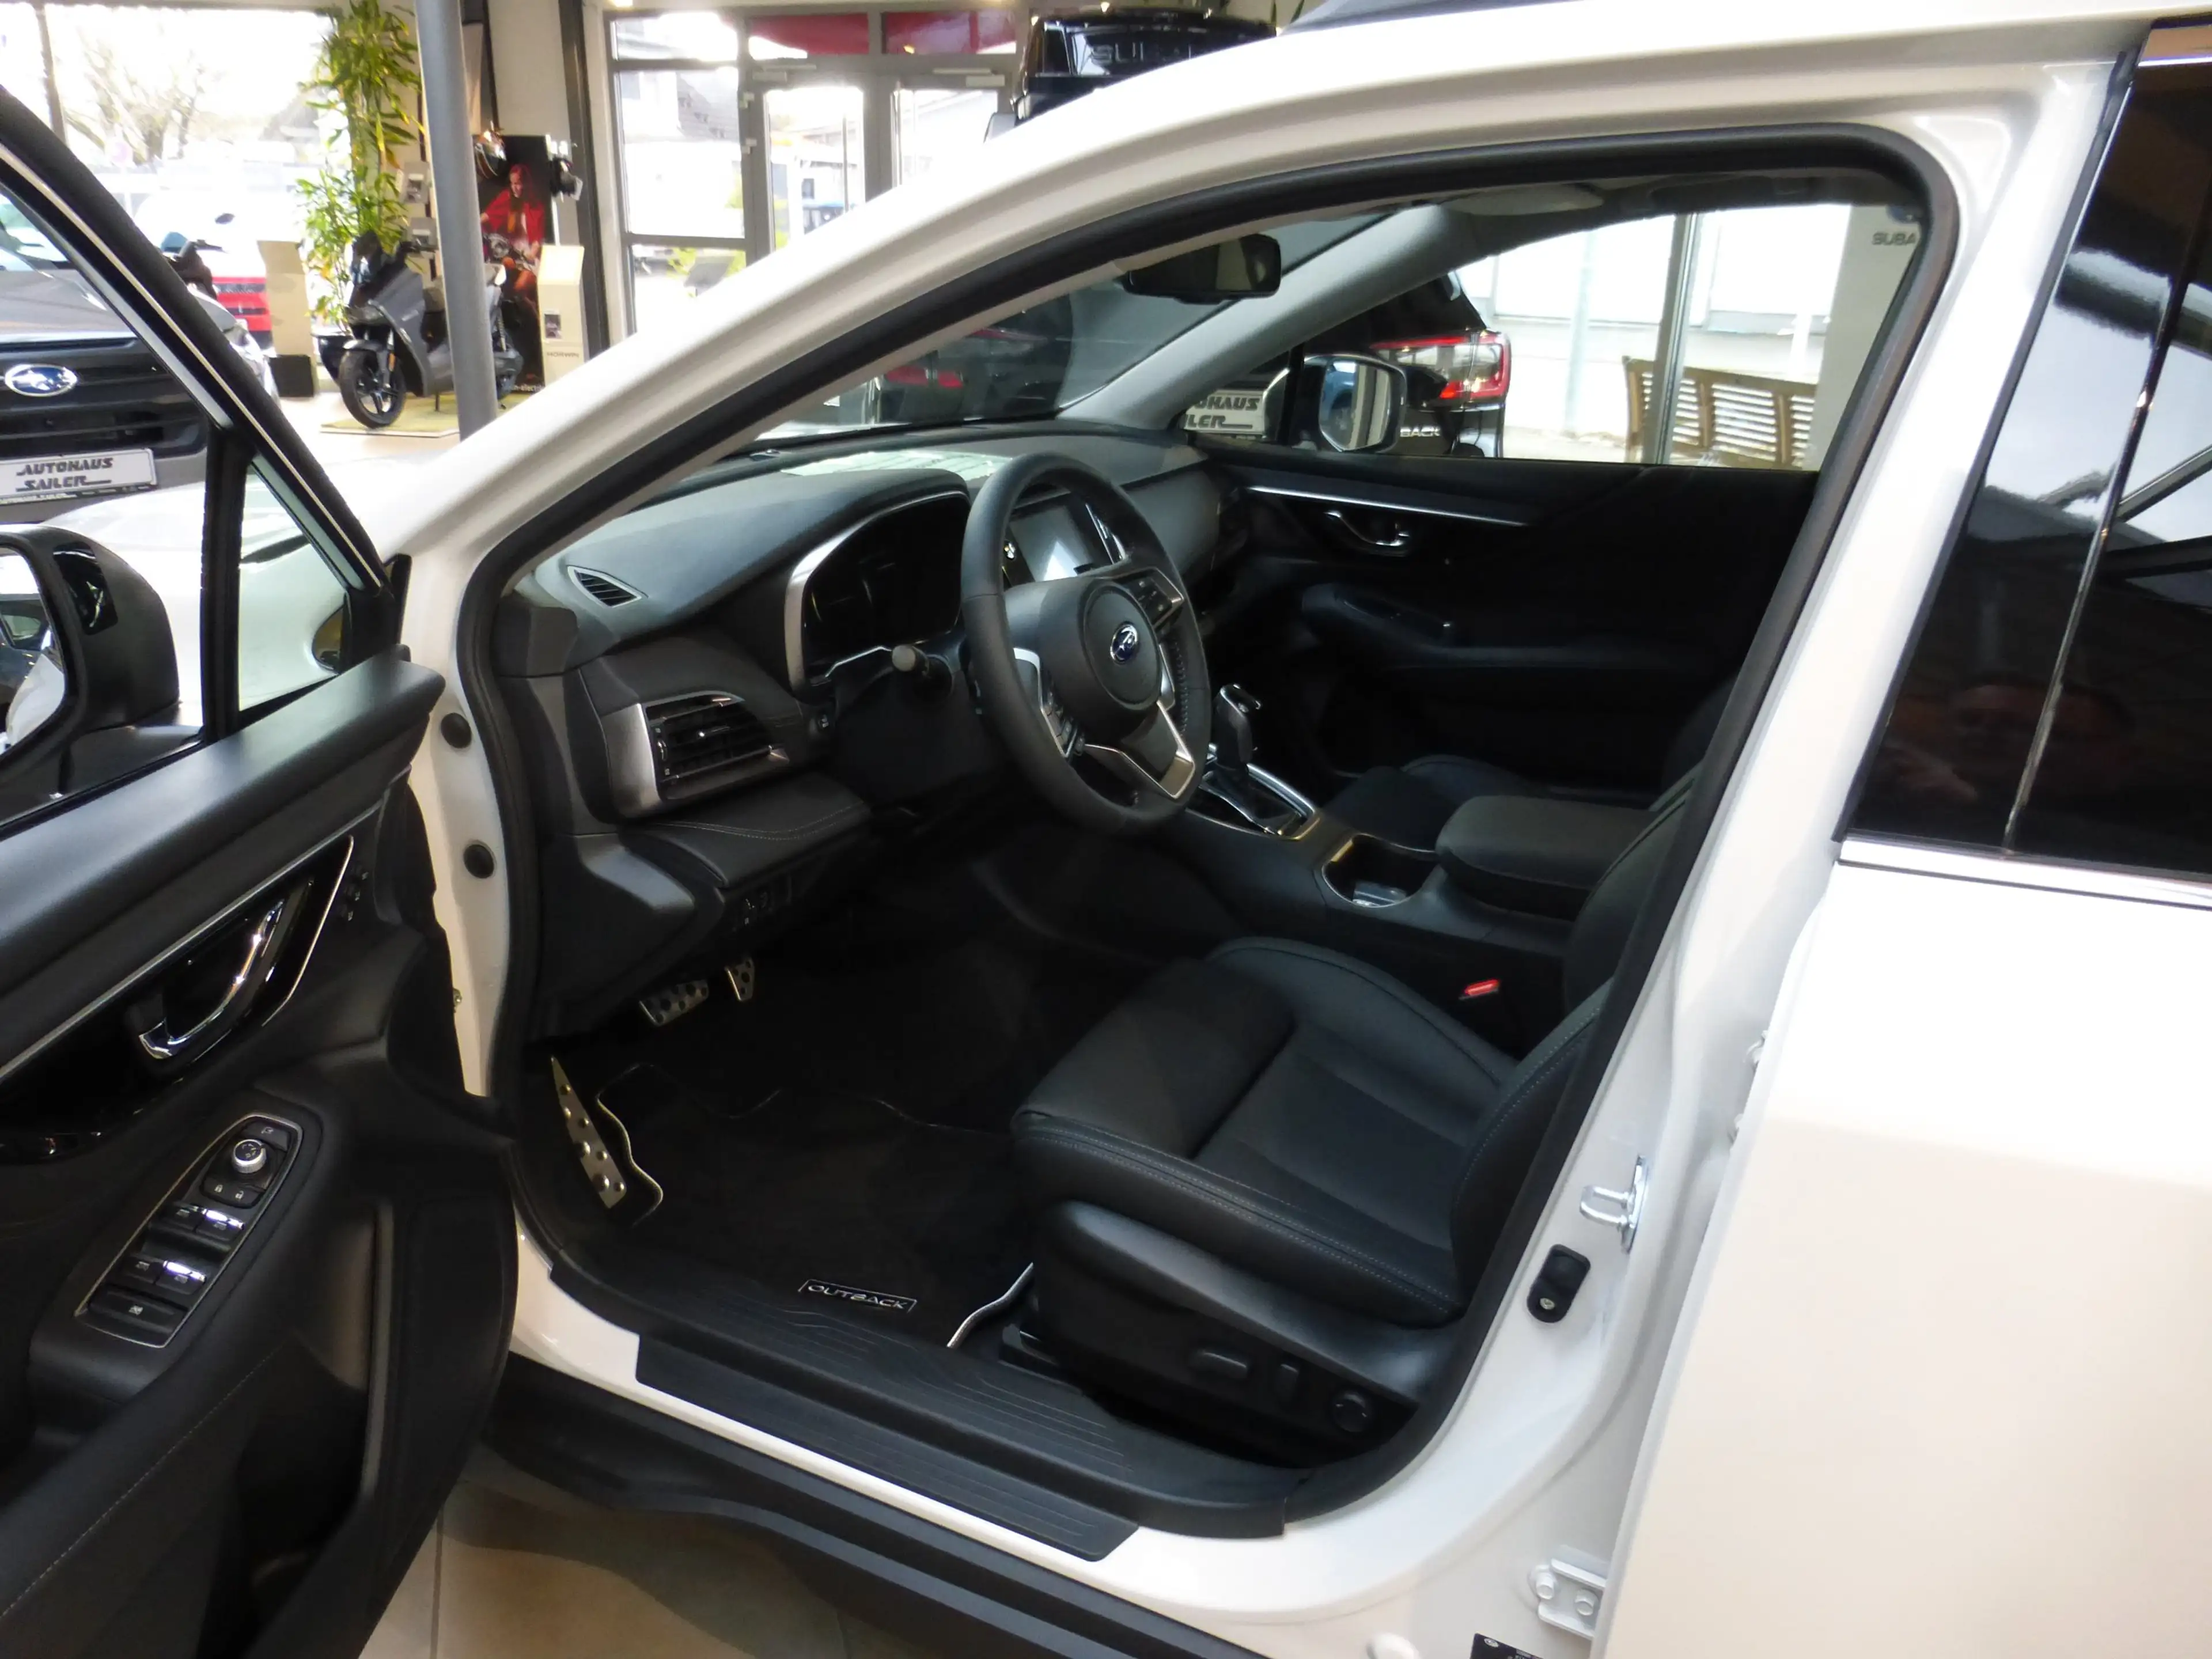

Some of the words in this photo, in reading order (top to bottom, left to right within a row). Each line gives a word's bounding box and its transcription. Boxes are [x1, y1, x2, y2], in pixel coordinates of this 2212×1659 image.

[1400, 426, 1440, 437] BACK
[16, 457, 113, 476] AUTOHAUS
[16, 475, 112, 492] SAILER
[808, 1285, 907, 1309] OUTBACK
